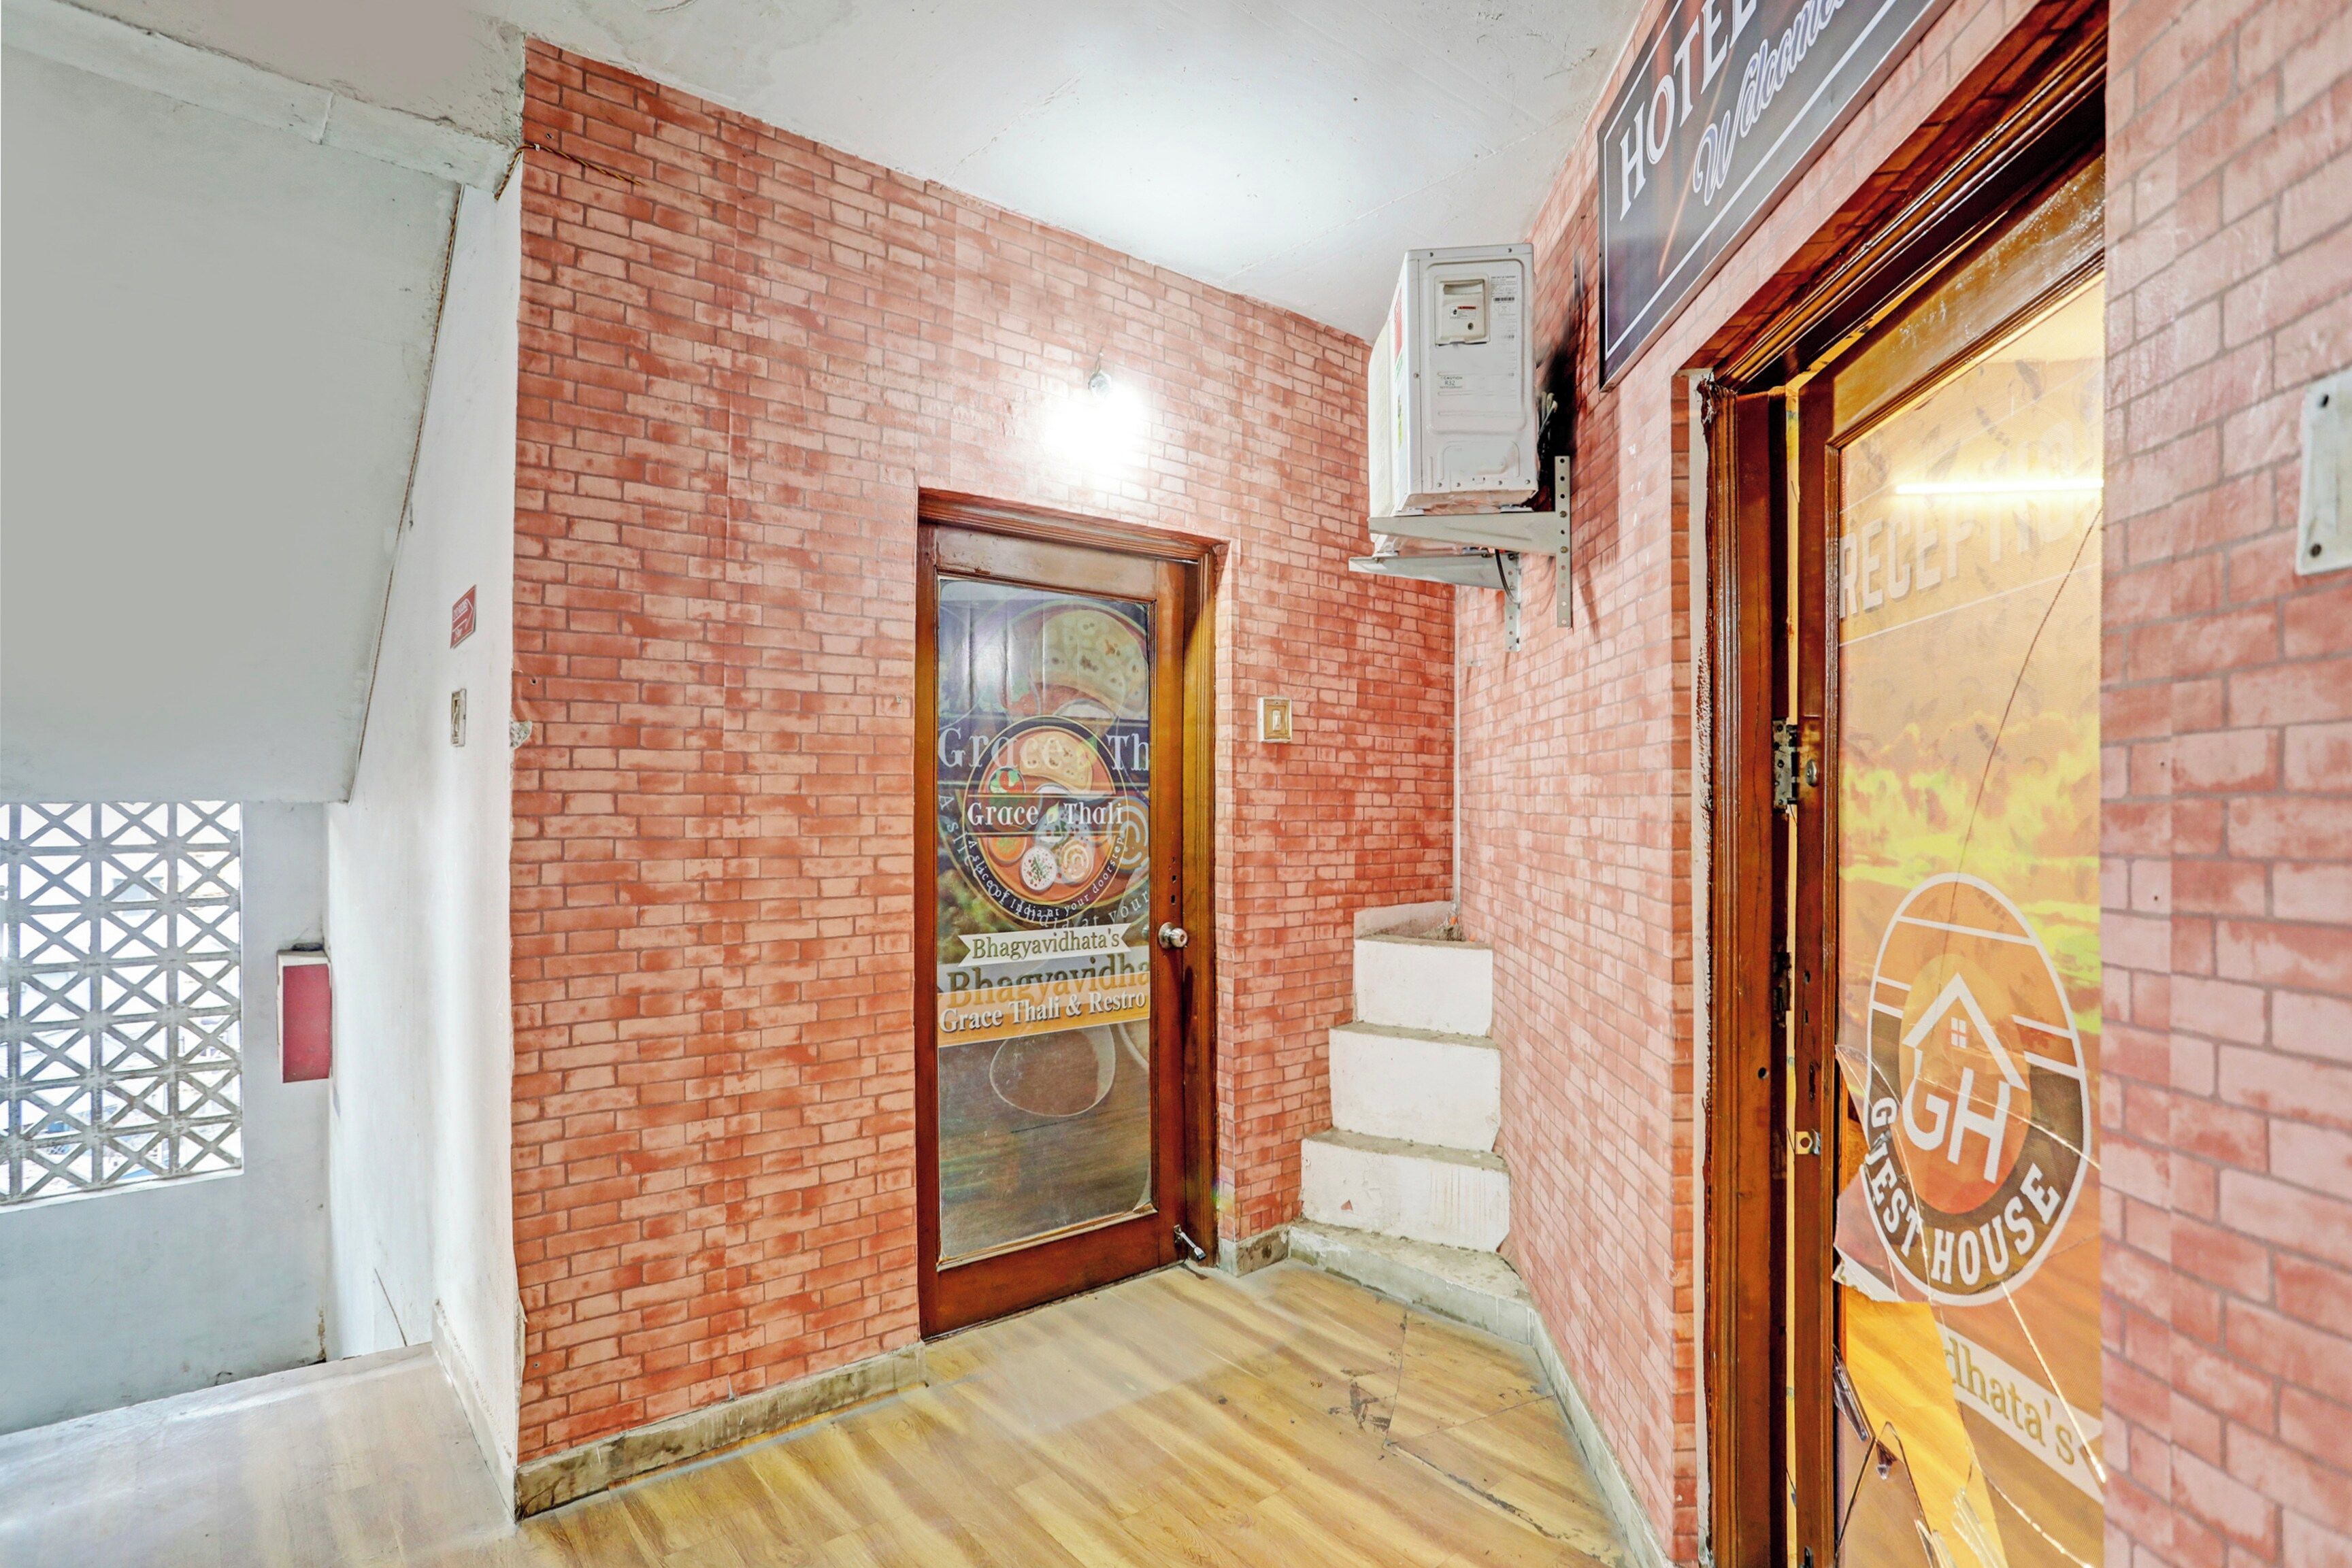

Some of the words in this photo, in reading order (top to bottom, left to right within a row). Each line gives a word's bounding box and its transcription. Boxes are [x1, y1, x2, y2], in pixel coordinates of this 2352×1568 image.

[1693, 0, 1846, 205] Welcome
[938, 727, 1062, 769] Grace
[967, 802, 1039, 826] Grace
[1063, 801, 1124, 825] Thali
[968, 840, 978, 850] A
[1064, 894, 1089, 916] your
[1092, 837, 1125, 894] doorstep
[972, 929, 1120, 961] Bhagyavidhata's
[939, 1009, 1004, 1033] Grace
[1008, 997, 1061, 1024] Thali
[1065, 993, 1082, 1017] &
[1089, 989, 1146, 1014] Restro
[1902, 1054, 2010, 1184] GH
[1930, 1162, 2061, 1286] HOUSE
